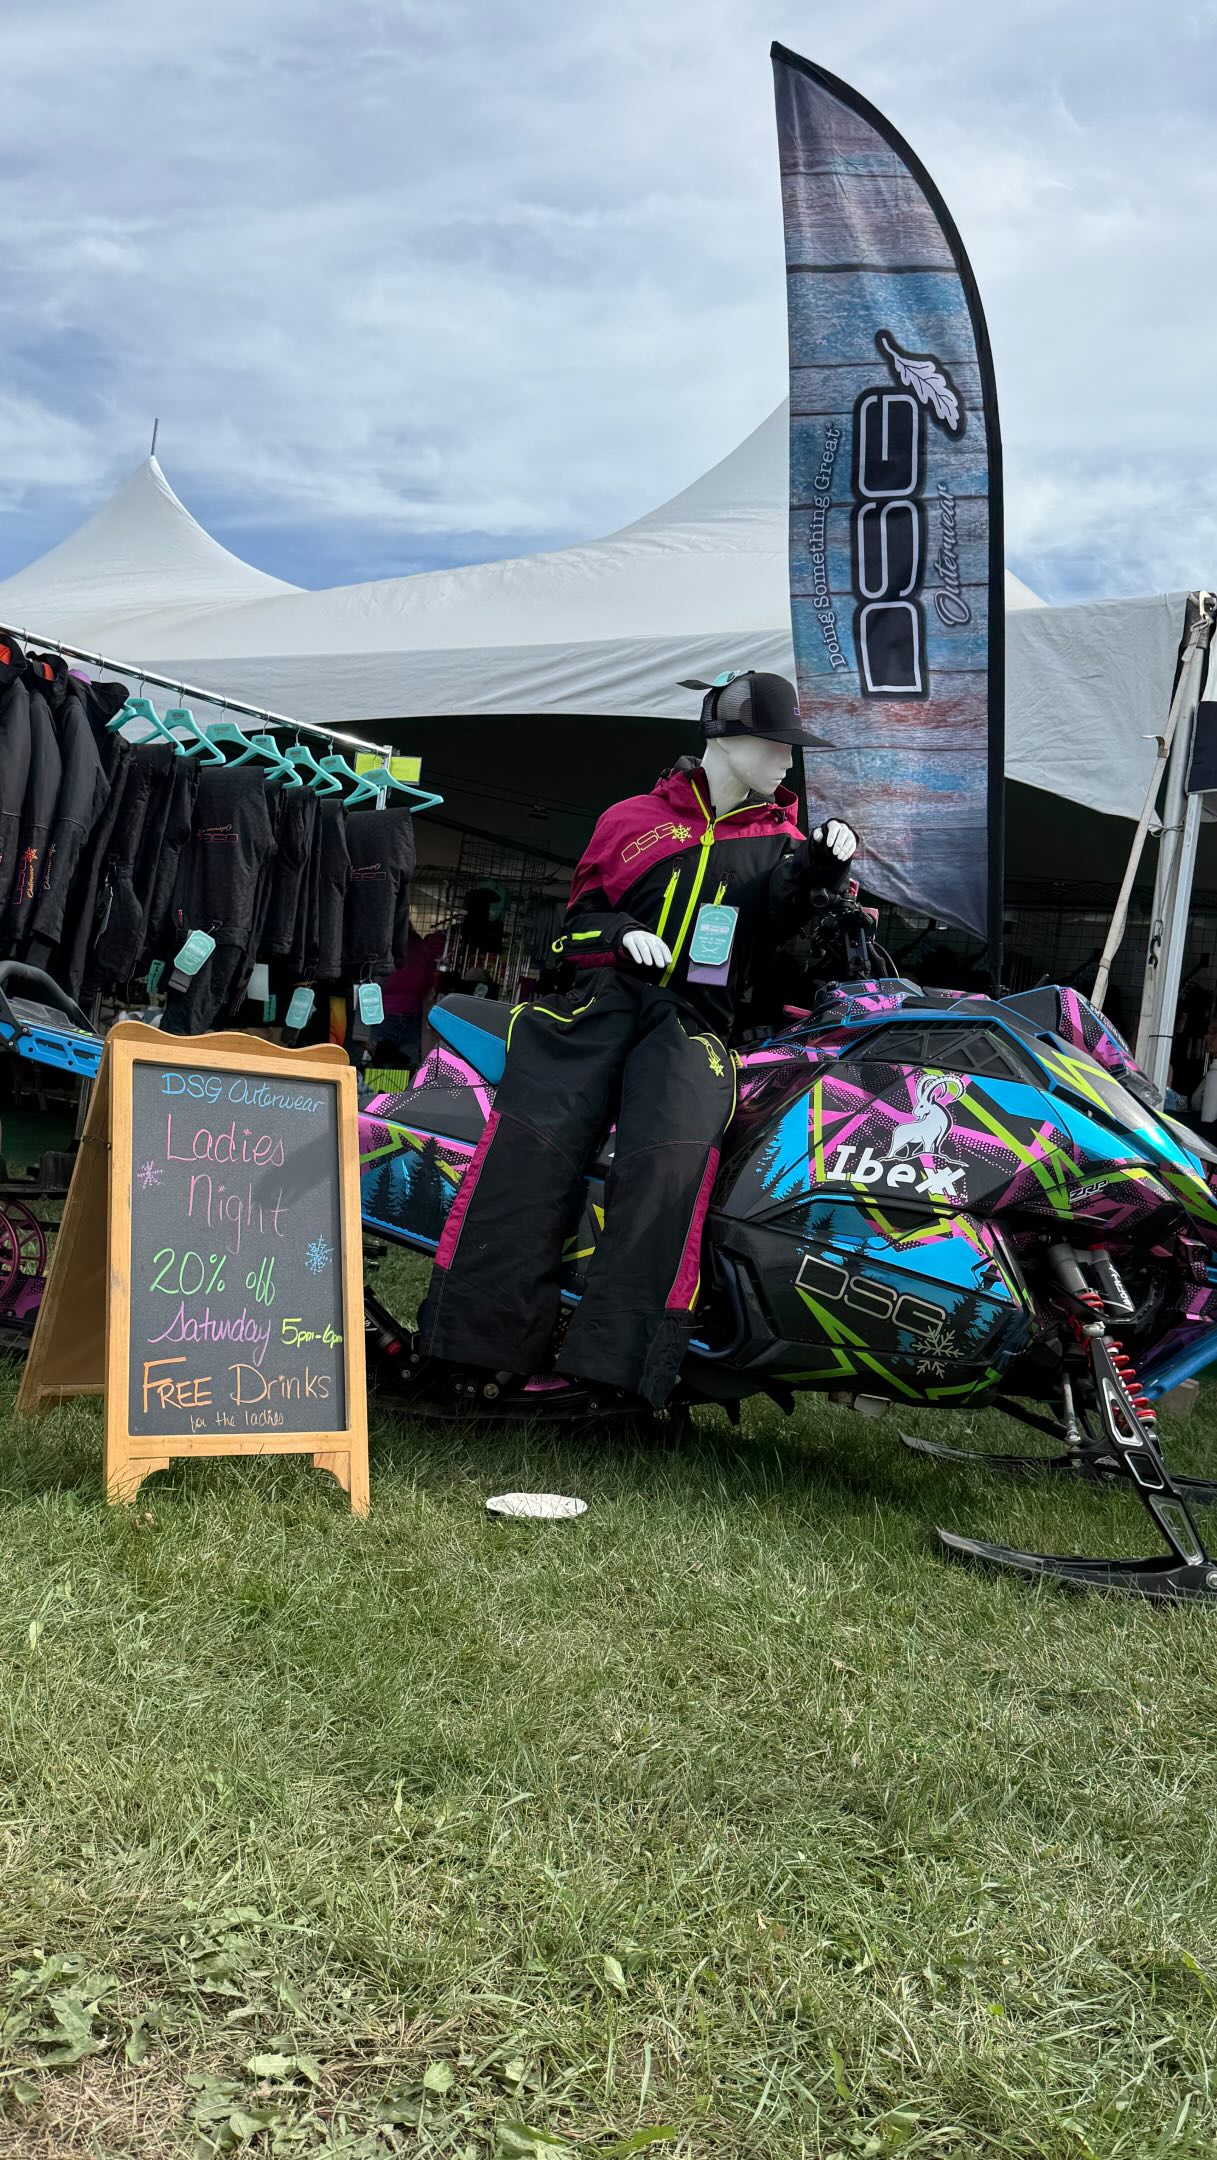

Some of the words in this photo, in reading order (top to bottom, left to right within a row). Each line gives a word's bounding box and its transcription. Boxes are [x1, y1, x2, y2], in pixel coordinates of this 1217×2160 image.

[814, 428, 840, 490] Great
[808, 495, 831, 609] Something
[857, 394, 922, 693] DSG
[934, 484, 970, 625] Outerwear
[818, 611, 846, 669] Doing
[161, 1072, 222, 1104] DSG
[228, 1077, 326, 1112] Outerwear
[167, 1113, 285, 1167] Ladies
[1069, 1179, 1109, 1202] ZRP
[149, 1247, 227, 1295] 20%
[245, 1256, 276, 1306] off
[794, 1254, 947, 1337] DSG
[147, 1301, 271, 1367] Saturday
[143, 1356, 212, 1413] FREE
[228, 1363, 331, 1406] Drinks
[190, 1414, 208, 1433] for
[215, 1411, 235, 1426] the
[245, 1410, 284, 1427] ladies
